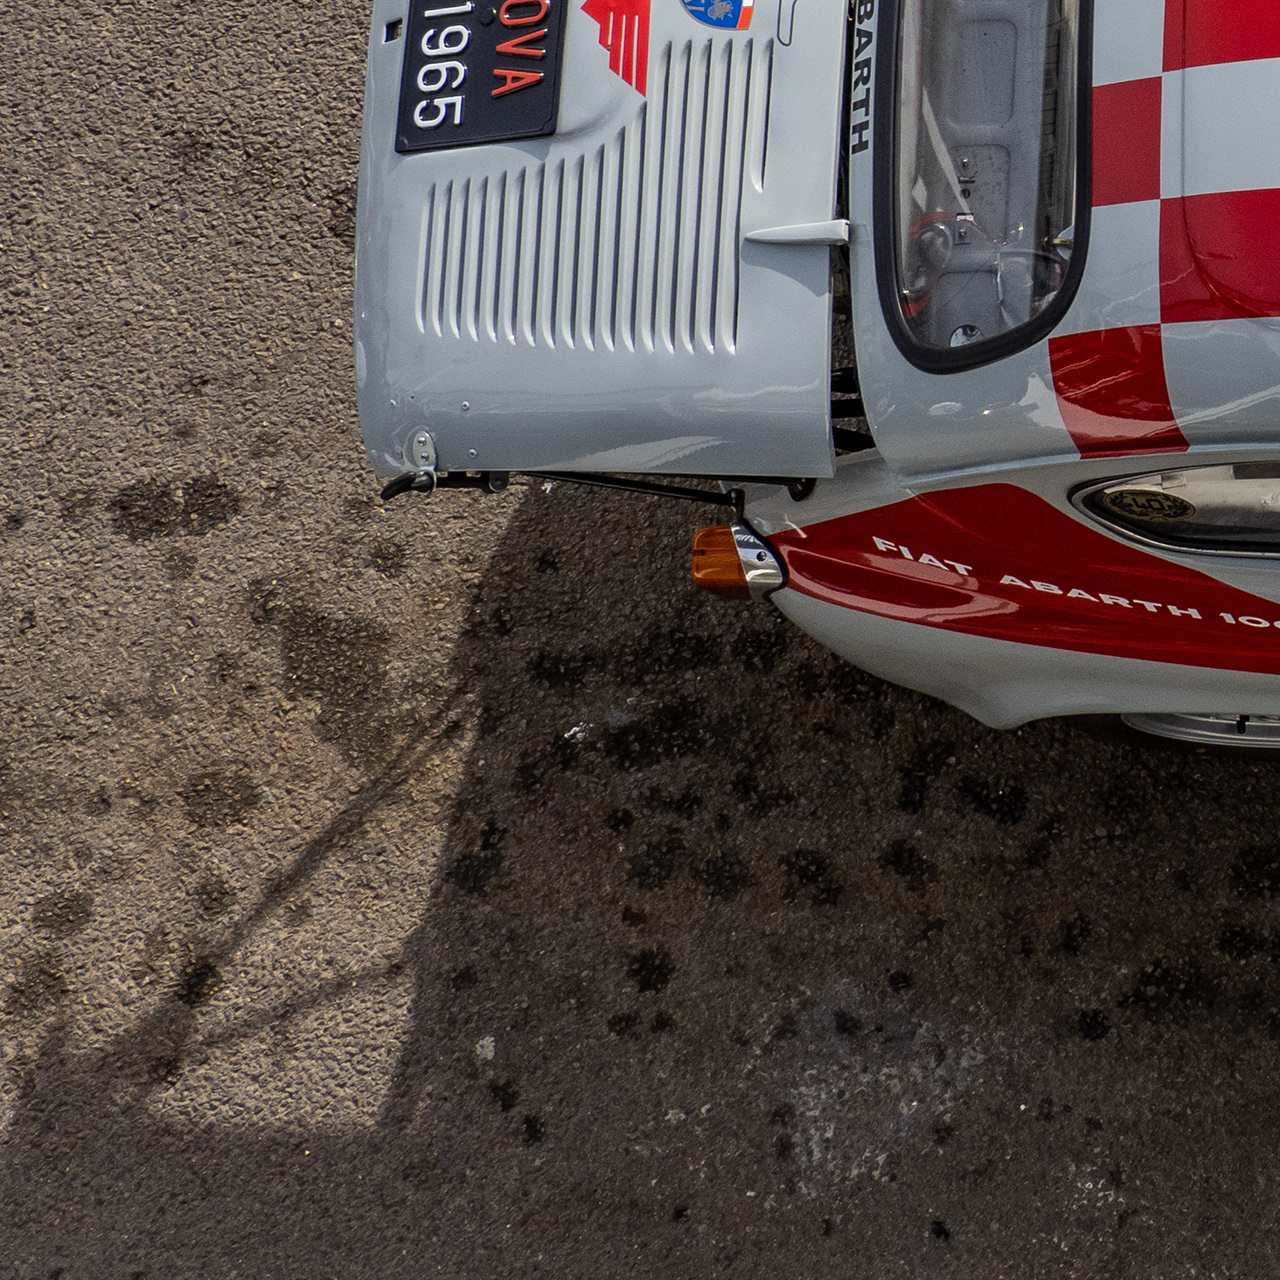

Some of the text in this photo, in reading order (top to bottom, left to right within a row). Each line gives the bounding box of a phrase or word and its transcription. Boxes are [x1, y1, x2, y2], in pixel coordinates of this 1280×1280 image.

[413, 0, 476, 129] 1965
[872, 535, 974, 577] FIAT
[999, 574, 1203, 620] ABARTH
